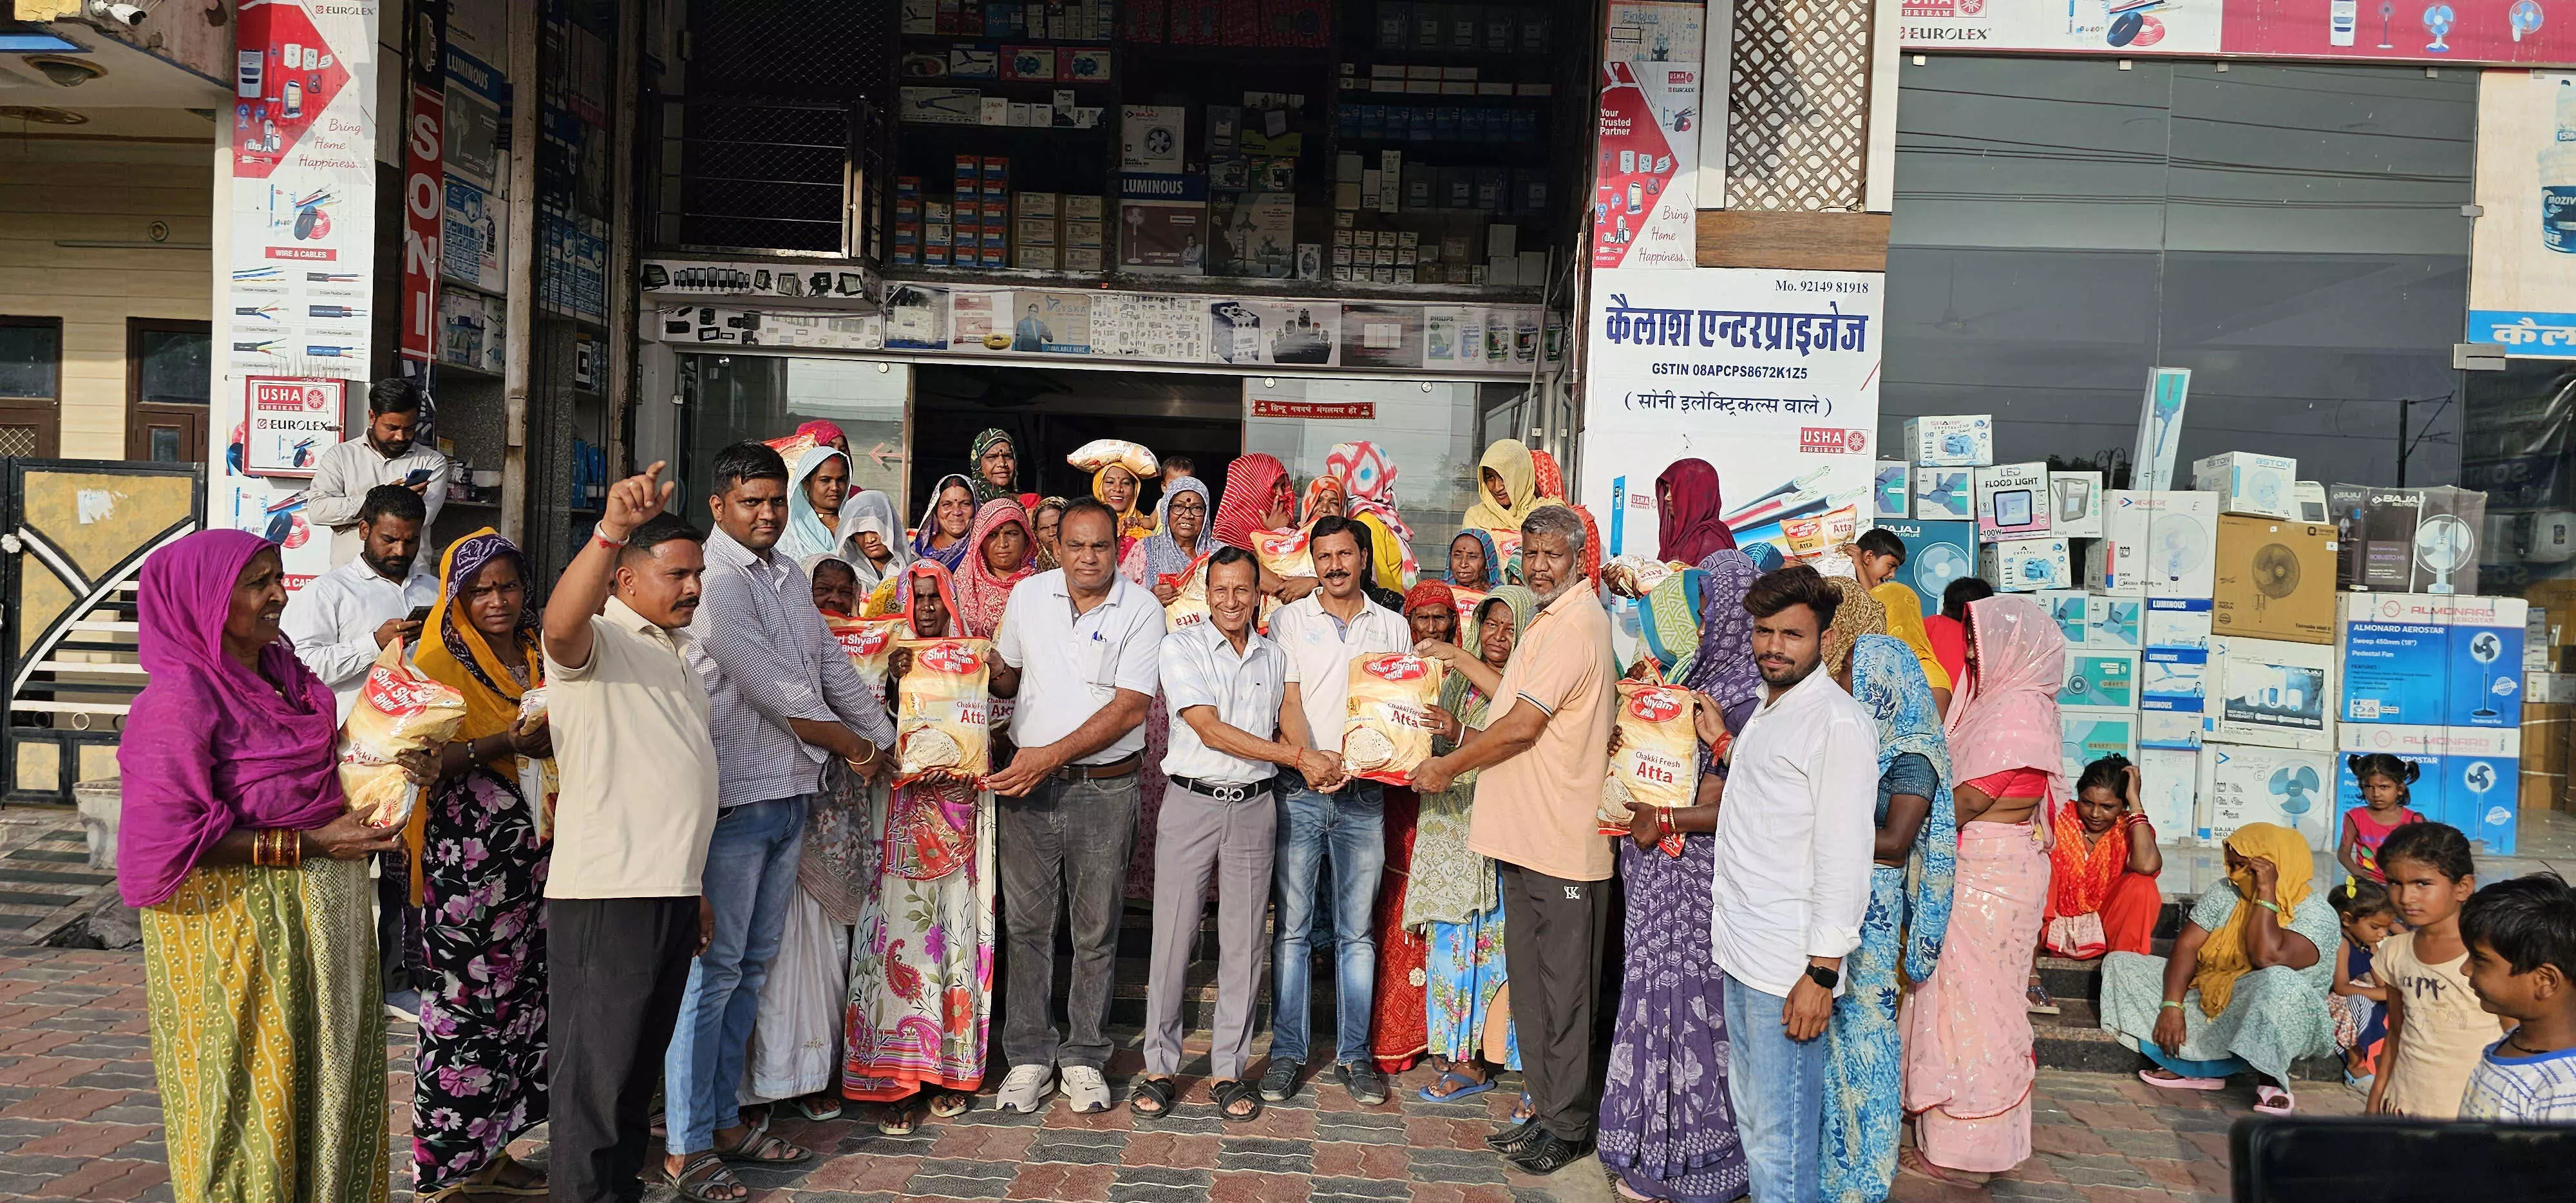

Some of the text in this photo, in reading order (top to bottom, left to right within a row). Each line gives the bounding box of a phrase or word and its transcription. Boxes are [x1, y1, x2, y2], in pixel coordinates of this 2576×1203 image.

[327, 6, 374, 15] EUROLEX
[1909, 28, 1987, 40] EUROLEX
[446, 52, 489, 91] LUMINOUS
[1600, 108, 1618, 117] Your
[329, 118, 362, 135] Bring
[1600, 118, 1631, 127] Trusted
[1600, 127, 1631, 135] Partner
[314, 137, 346, 149] Home
[1122, 179, 1183, 194] LUMINOUS
[1663, 205, 1689, 224] Bring
[407, 114, 440, 336] SONI
[1651, 226, 1676, 242] Home
[1775, 280, 1869, 294] Mo. 92149 81918
[1605, 294, 1869, 357] कैलाश एन्टरप्राइजेज
[1046, 345, 1072, 353] AVAILABLE
[1652, 363, 1808, 380] GSTIN 08APCPS8672K1Z5
[260, 388, 301, 401] USHA
[1637, 389, 1677, 410] सोनी
[1783, 395, 1820, 414] वाले
[1270, 403, 1288, 414] हिन्दू
[1348, 405, 1358, 414] हो
[270, 419, 327, 431] EUROLEX
[1803, 430, 1842, 444] USHA
[2000, 467, 2021, 477] LED
[1985, 477, 2038, 488] FLOOD LIGHT
[1632, 495, 1649, 506] USHA
[1833, 523, 1852, 533] Atta
[284, 578, 290, 587] &
[2152, 600, 2186, 609] LUMINOUS
[2410, 606, 2496, 617] ALMONARD
[1175, 612, 1200, 626] Atta
[2353, 623, 2445, 634] ALMONARD AEROSTAR
[848, 633, 882, 645] Shyam
[842, 644, 864, 654] BHOG
[927, 649, 947, 661] Shri
[2149, 653, 2178, 661] LUMINOUS
[1371, 662, 1390, 673] Shri
[373, 667, 399, 691] Shri
[1387, 702, 1408, 713] Chakki
[1642, 695, 1673, 711] Shyam
[2143, 700, 2172, 708] LUMINOUS
[960, 709, 985, 725] Atta
[1392, 710, 1419, 729] Atta
[2403, 736, 2490, 747] ALMONARD
[1636, 751, 1681, 768] Chakki Fresh
[1636, 761, 1672, 784] Atta
